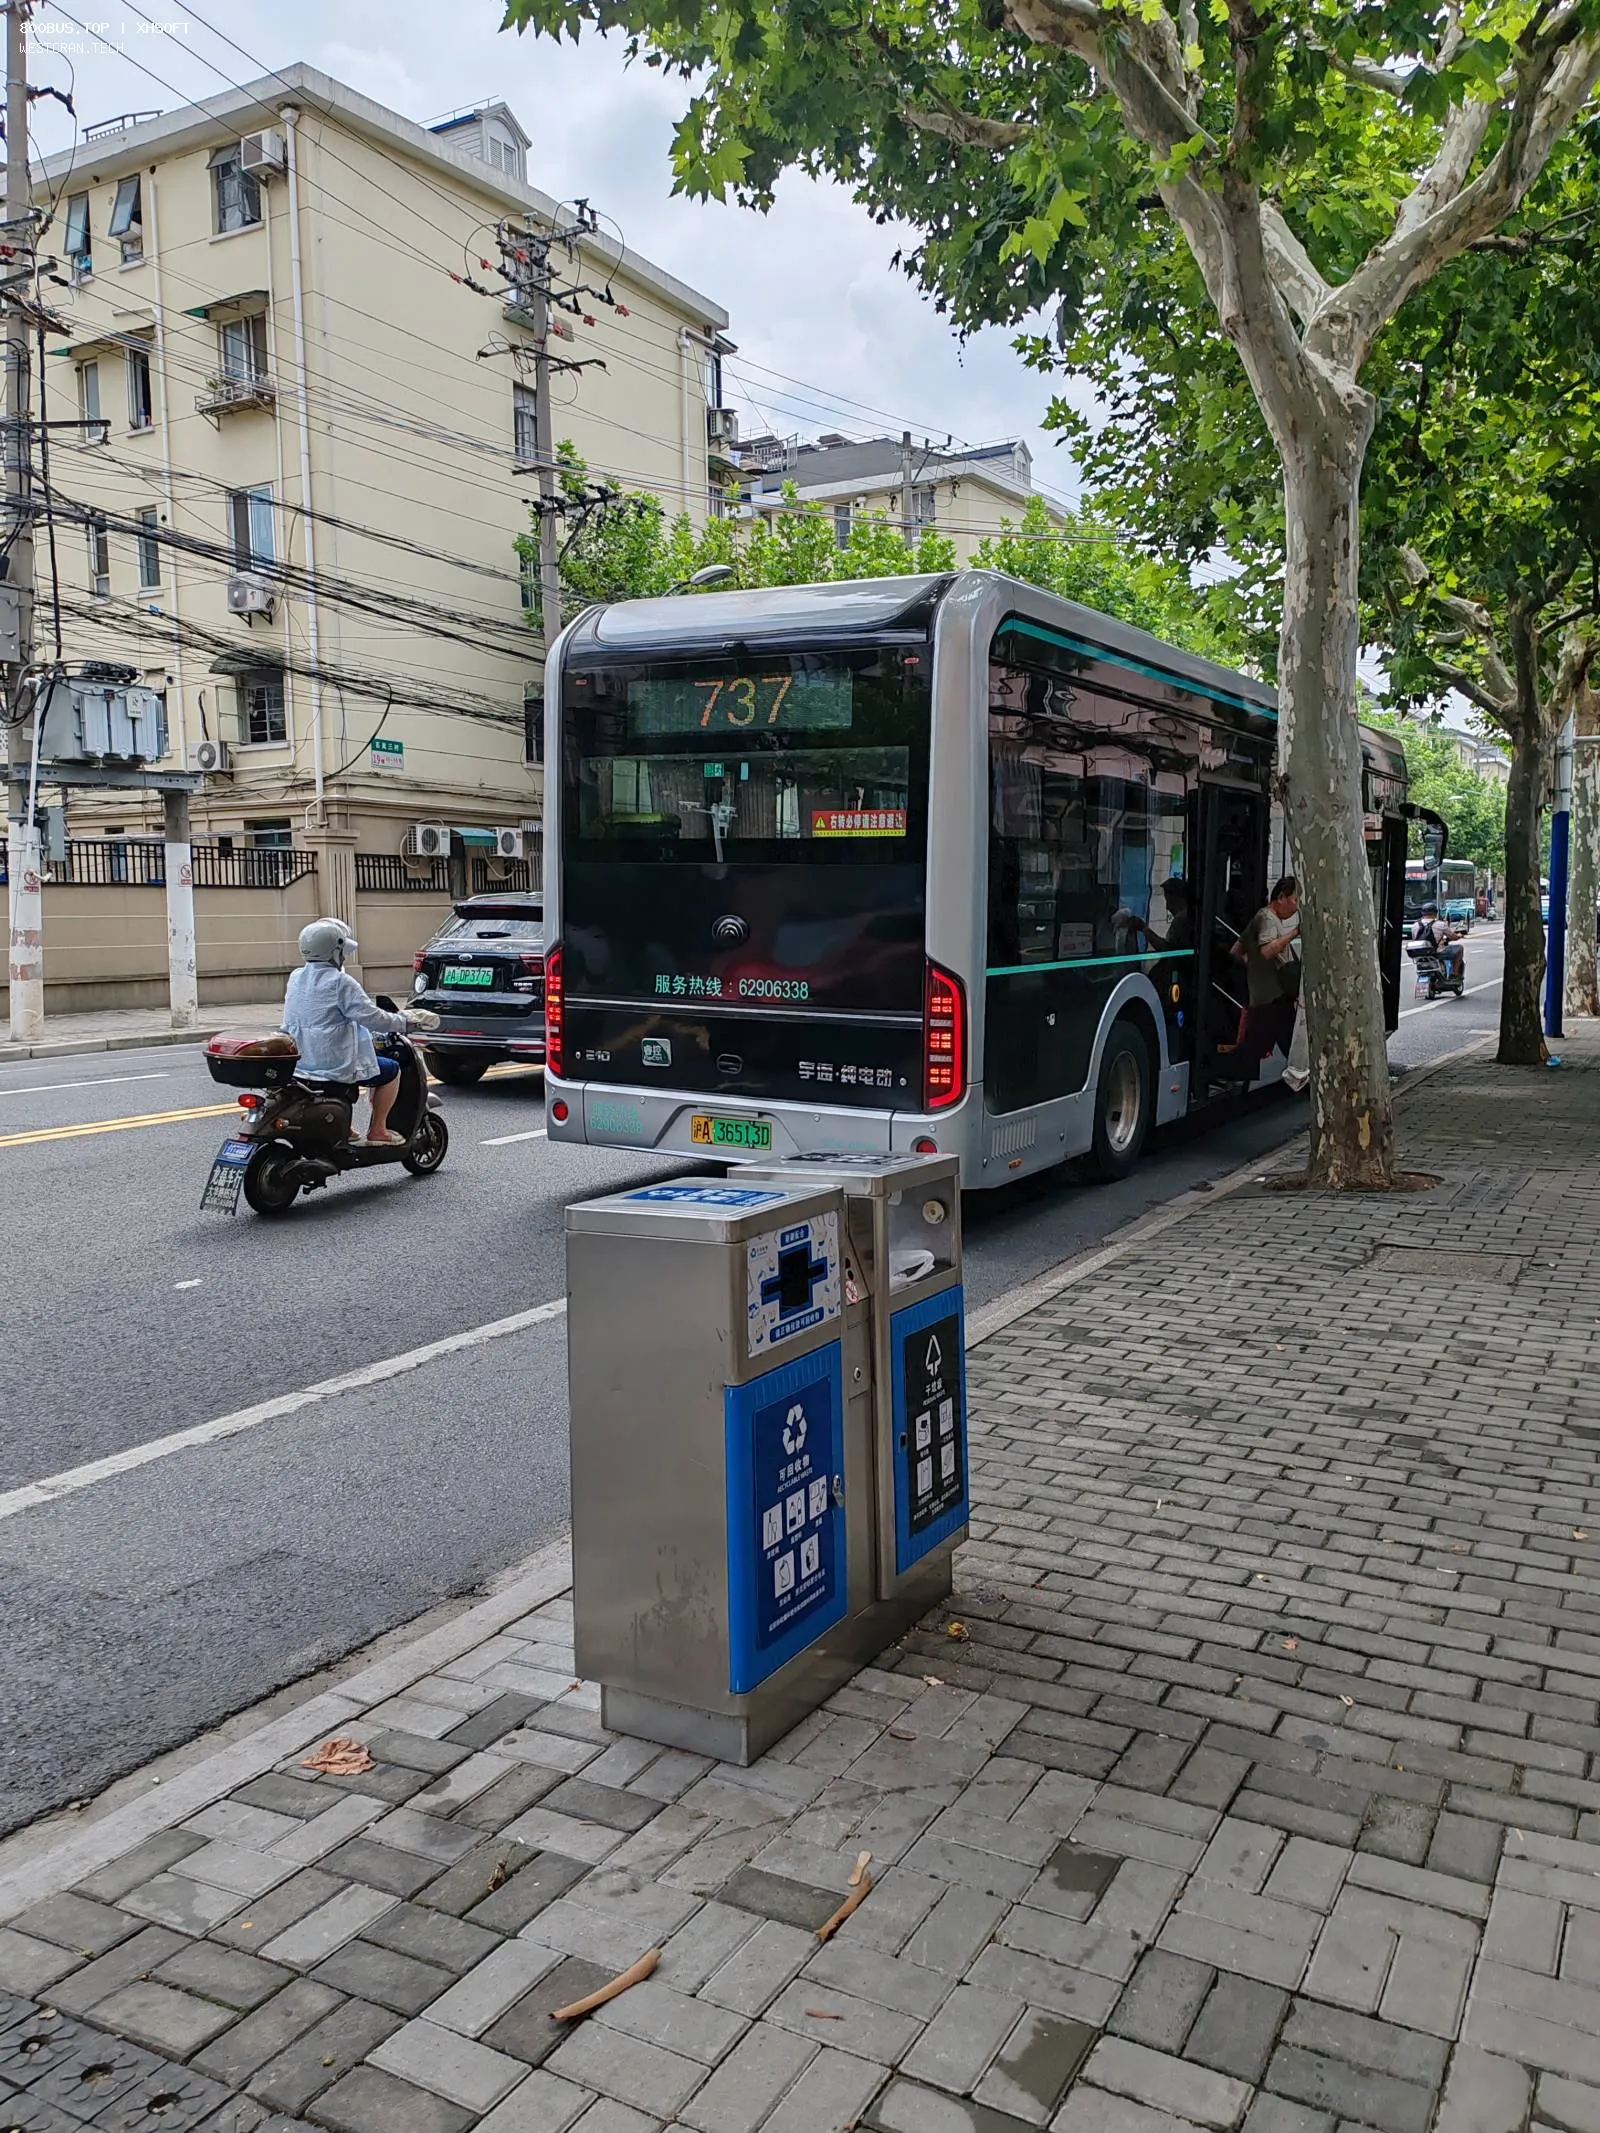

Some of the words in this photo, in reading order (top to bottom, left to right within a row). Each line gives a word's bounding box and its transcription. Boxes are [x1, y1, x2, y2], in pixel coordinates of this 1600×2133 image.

[694, 676, 792, 727] 737
[778, 1454, 810, 1482] 可回收物
